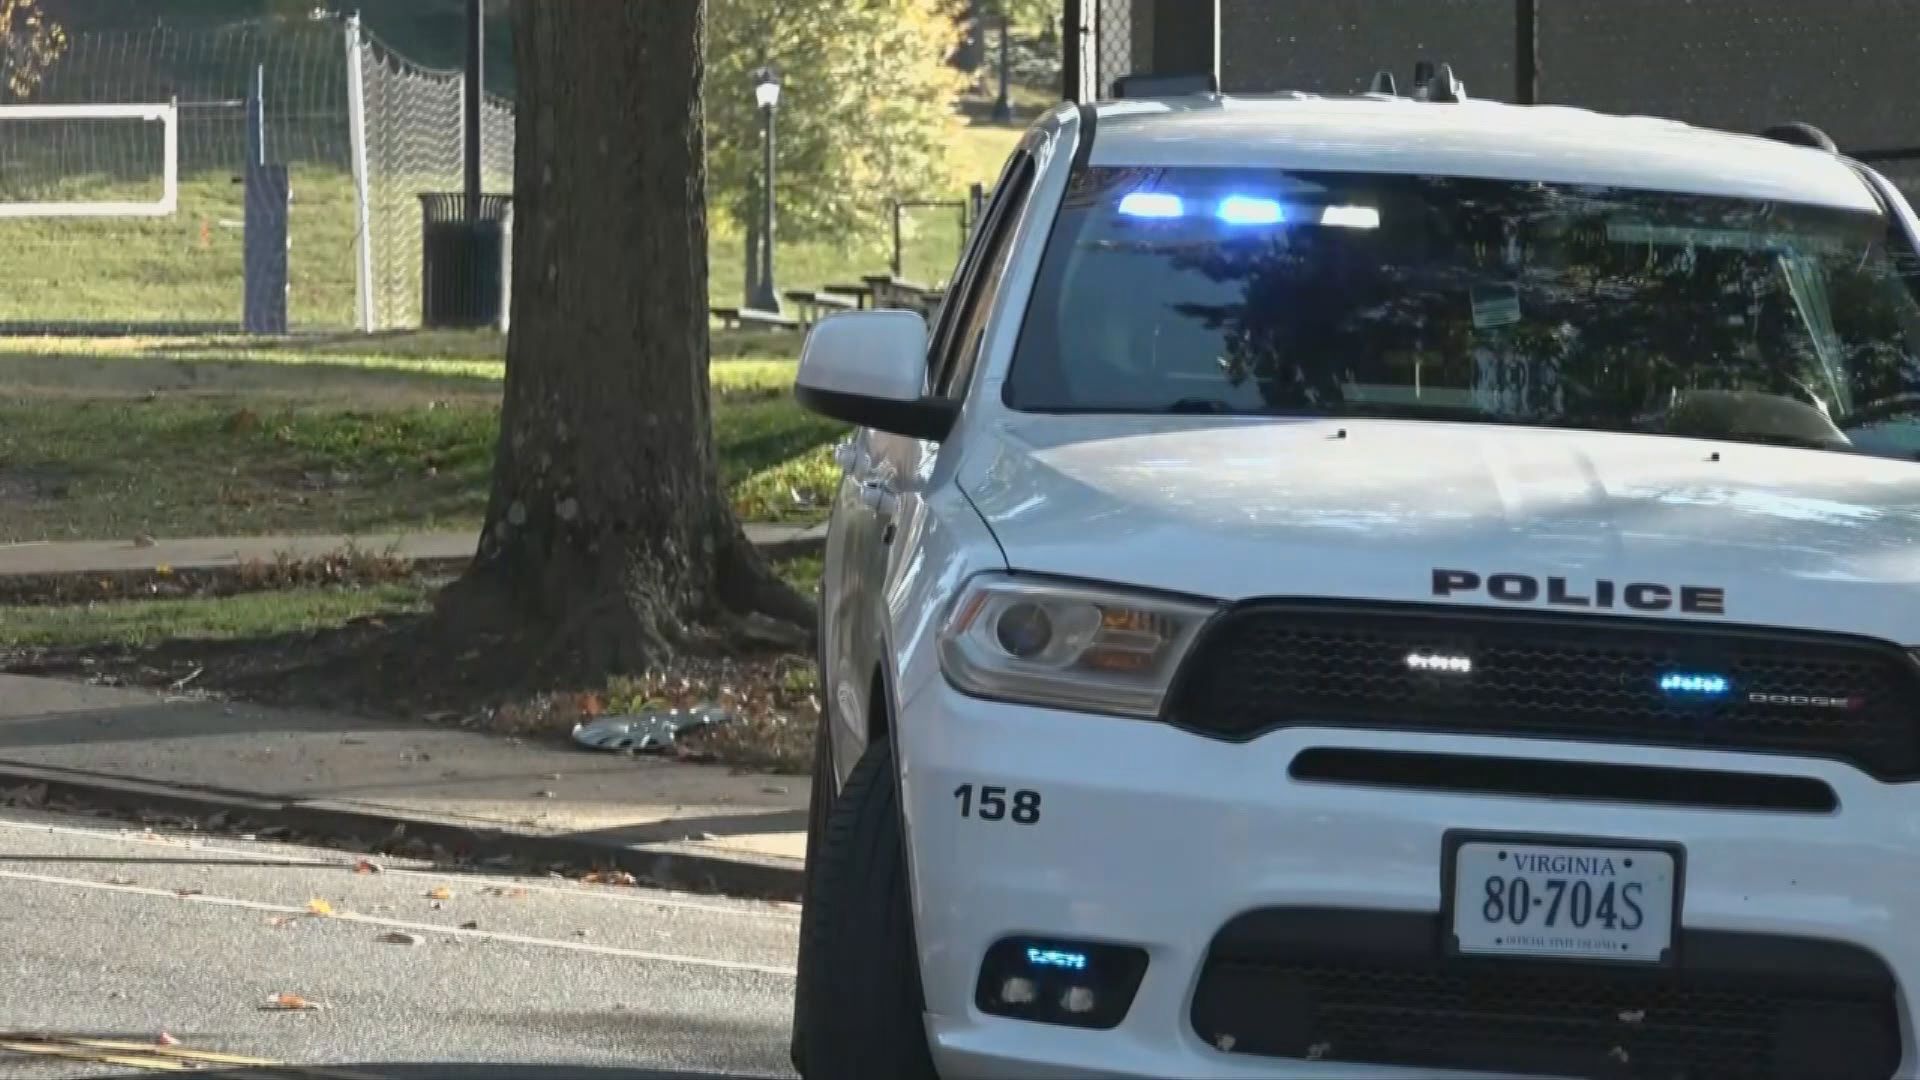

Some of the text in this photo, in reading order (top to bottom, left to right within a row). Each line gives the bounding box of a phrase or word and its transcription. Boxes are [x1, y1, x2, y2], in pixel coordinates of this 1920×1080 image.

[1431, 568, 1725, 614] POLICE
[1748, 692, 1848, 707] DODGE
[954, 783, 1041, 824] 158
[1514, 853, 1616, 875] VIRGINIA
